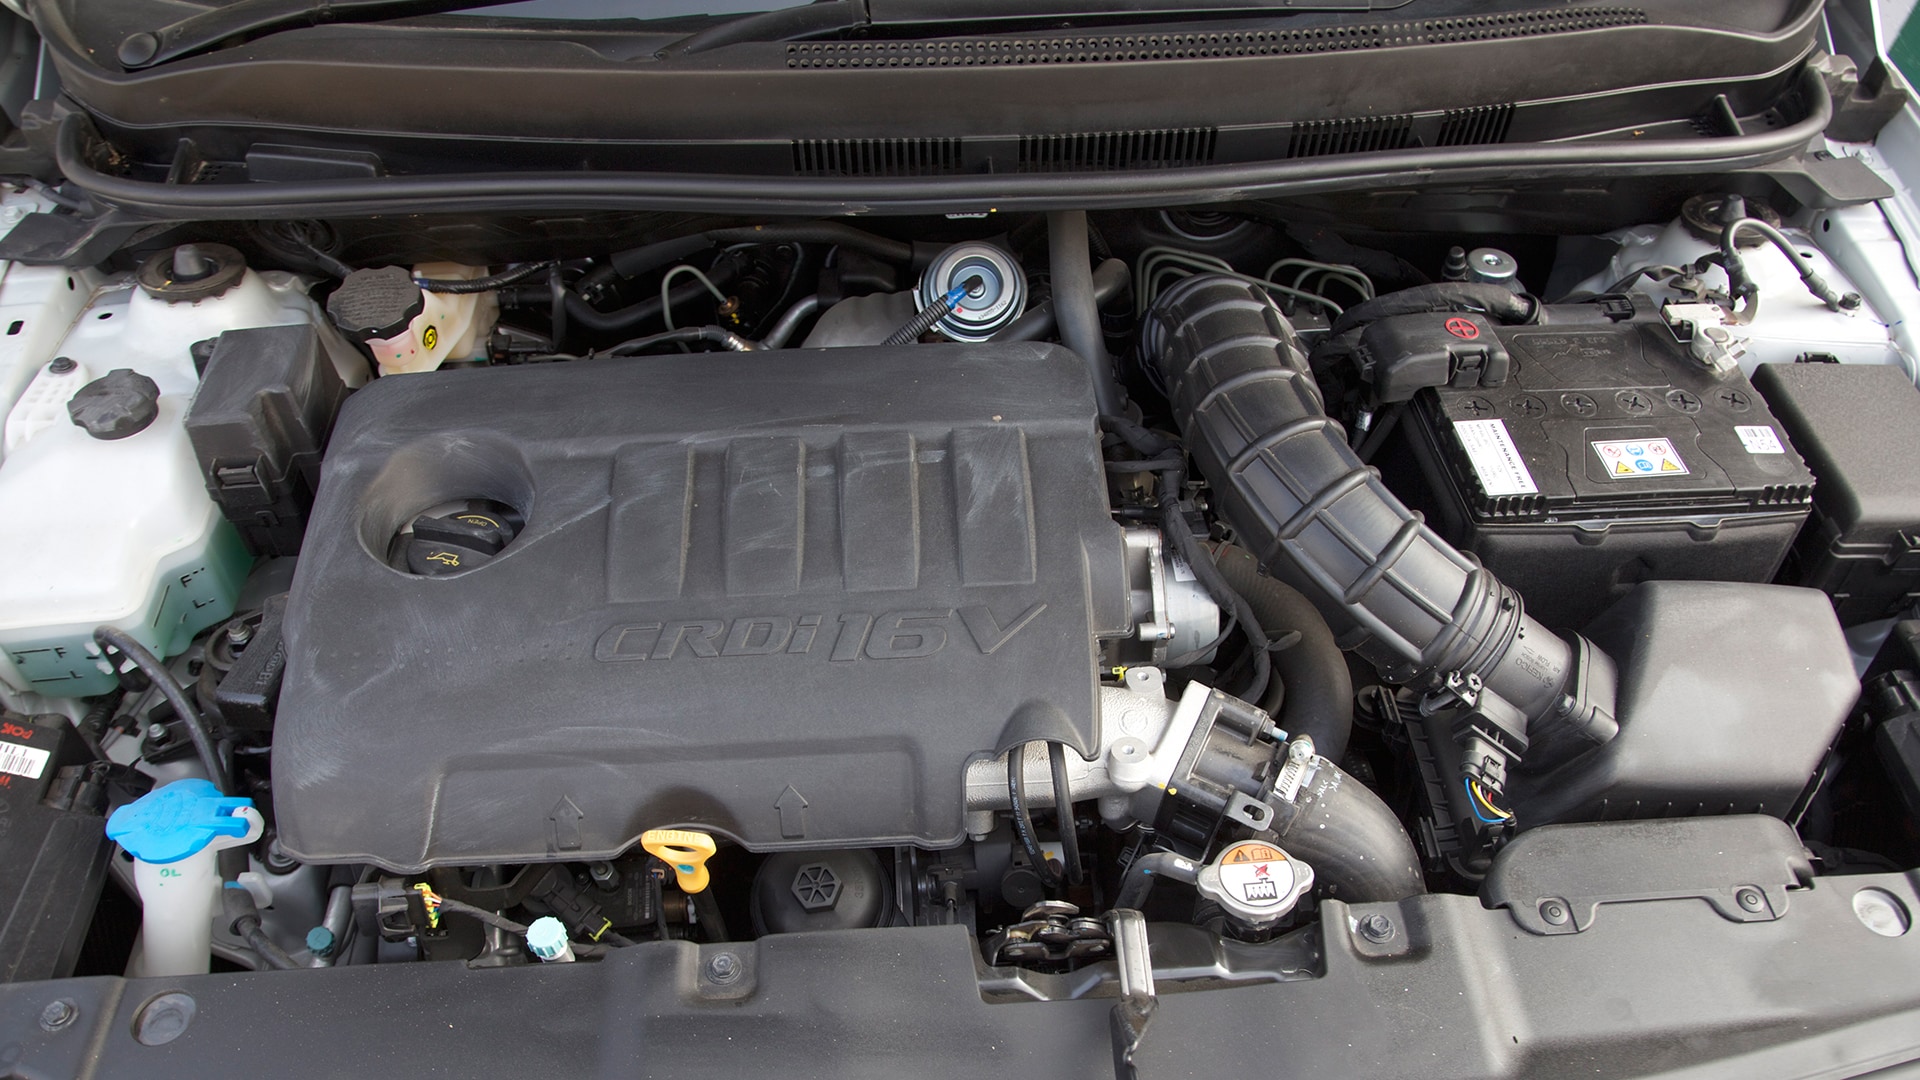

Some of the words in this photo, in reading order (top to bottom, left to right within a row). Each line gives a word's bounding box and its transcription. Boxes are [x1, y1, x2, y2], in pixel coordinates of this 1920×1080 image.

[1490, 423, 1516, 469] MAINTENANCE
[179, 573, 193, 588] F
[593, 613, 822, 662] CRDi
[54, 647, 67, 659] F
[69, 670, 84, 679] L
